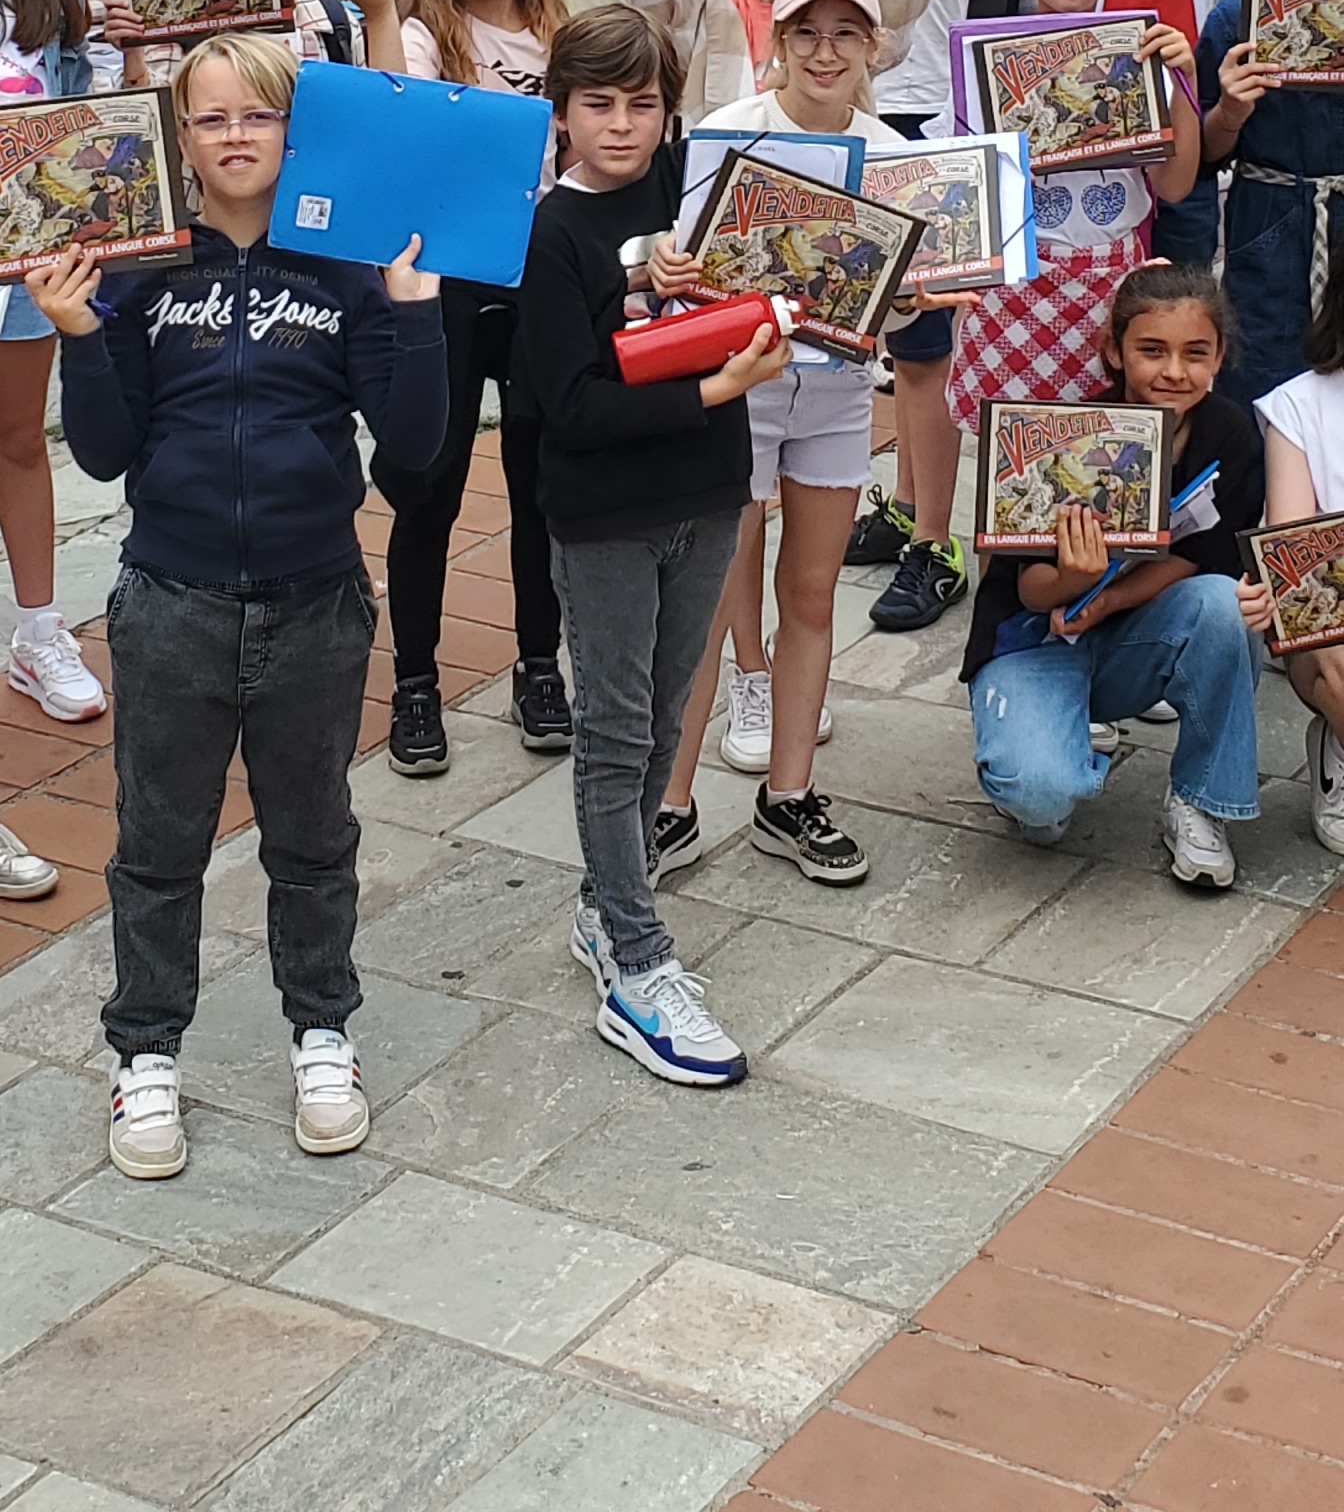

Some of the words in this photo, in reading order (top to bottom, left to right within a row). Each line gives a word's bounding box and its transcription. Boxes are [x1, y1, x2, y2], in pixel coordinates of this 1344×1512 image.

[993, 30, 1103, 107] VENDETTA
[732, 182, 857, 237] VENDETTA
[866, 221, 890, 236] CORSE
[106, 240, 144, 254] LANGUE
[145, 234, 176, 246] CORSE
[908, 270, 919, 281] ET
[919, 269, 930, 279] EN
[931, 263, 965, 278] LANGUE
[966, 259, 991, 271] CORSE
[248, 289, 343, 341] Jones
[268, 327, 306, 349] 1990
[835, 328, 863, 344] CORSE
[997, 411, 1114, 478] VENDETTA
[984, 534, 996, 544] EN
[997, 534, 1029, 544] LANGUE
[1132, 534, 1157, 542] CORSE
[1292, 631, 1324, 646] LANGUE
